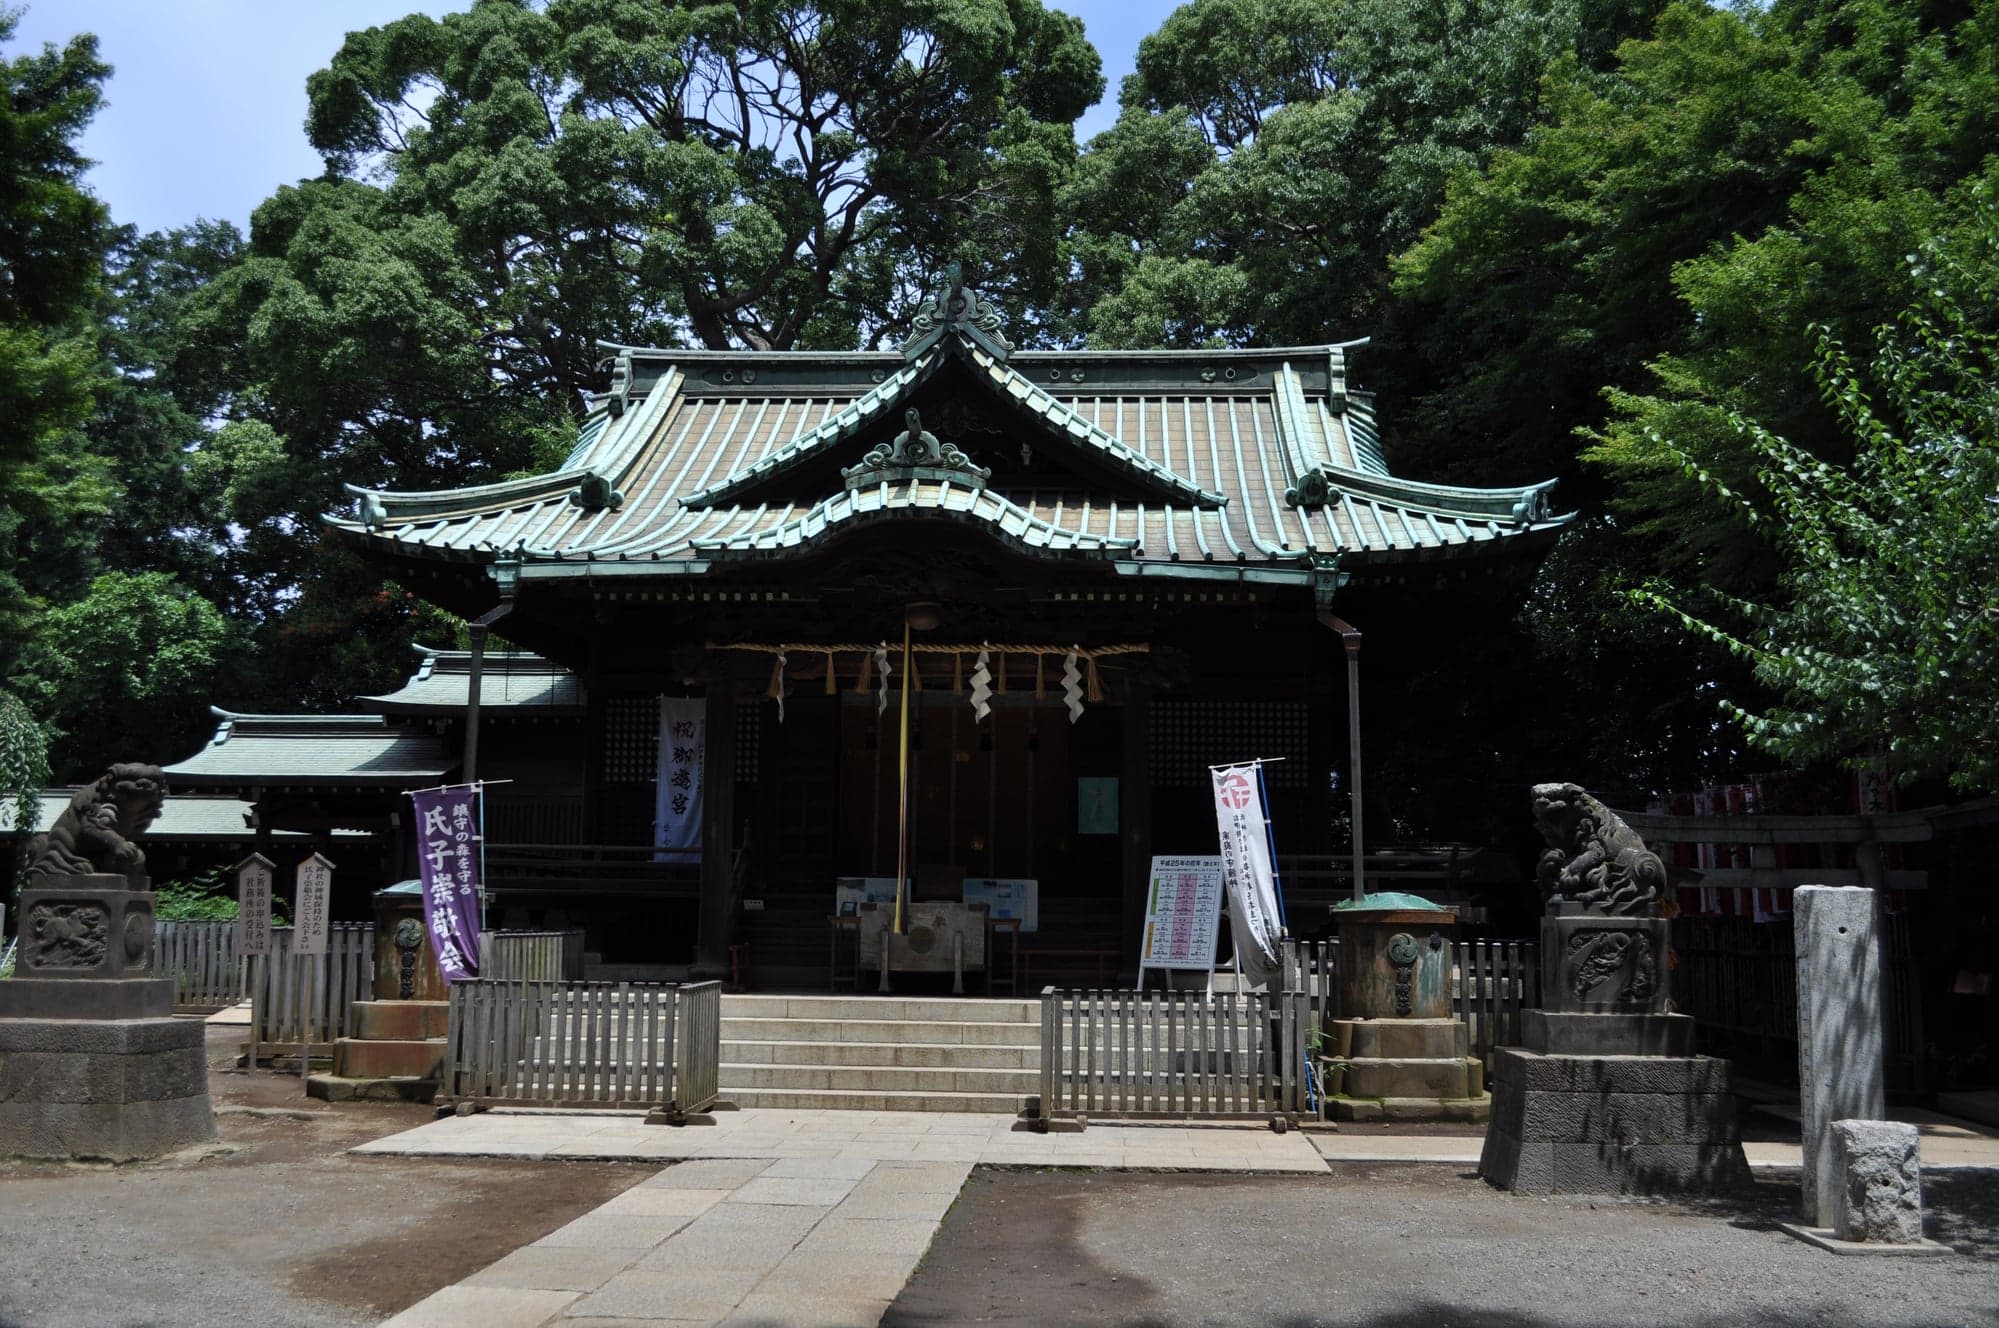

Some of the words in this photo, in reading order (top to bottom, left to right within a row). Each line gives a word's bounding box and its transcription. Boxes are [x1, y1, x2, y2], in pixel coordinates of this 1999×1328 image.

[671, 720, 695, 815] 祝御遷宮
[424, 805, 464, 972] 氏子崇敬会
[452, 803, 472, 895] 鎮守の森を守る
